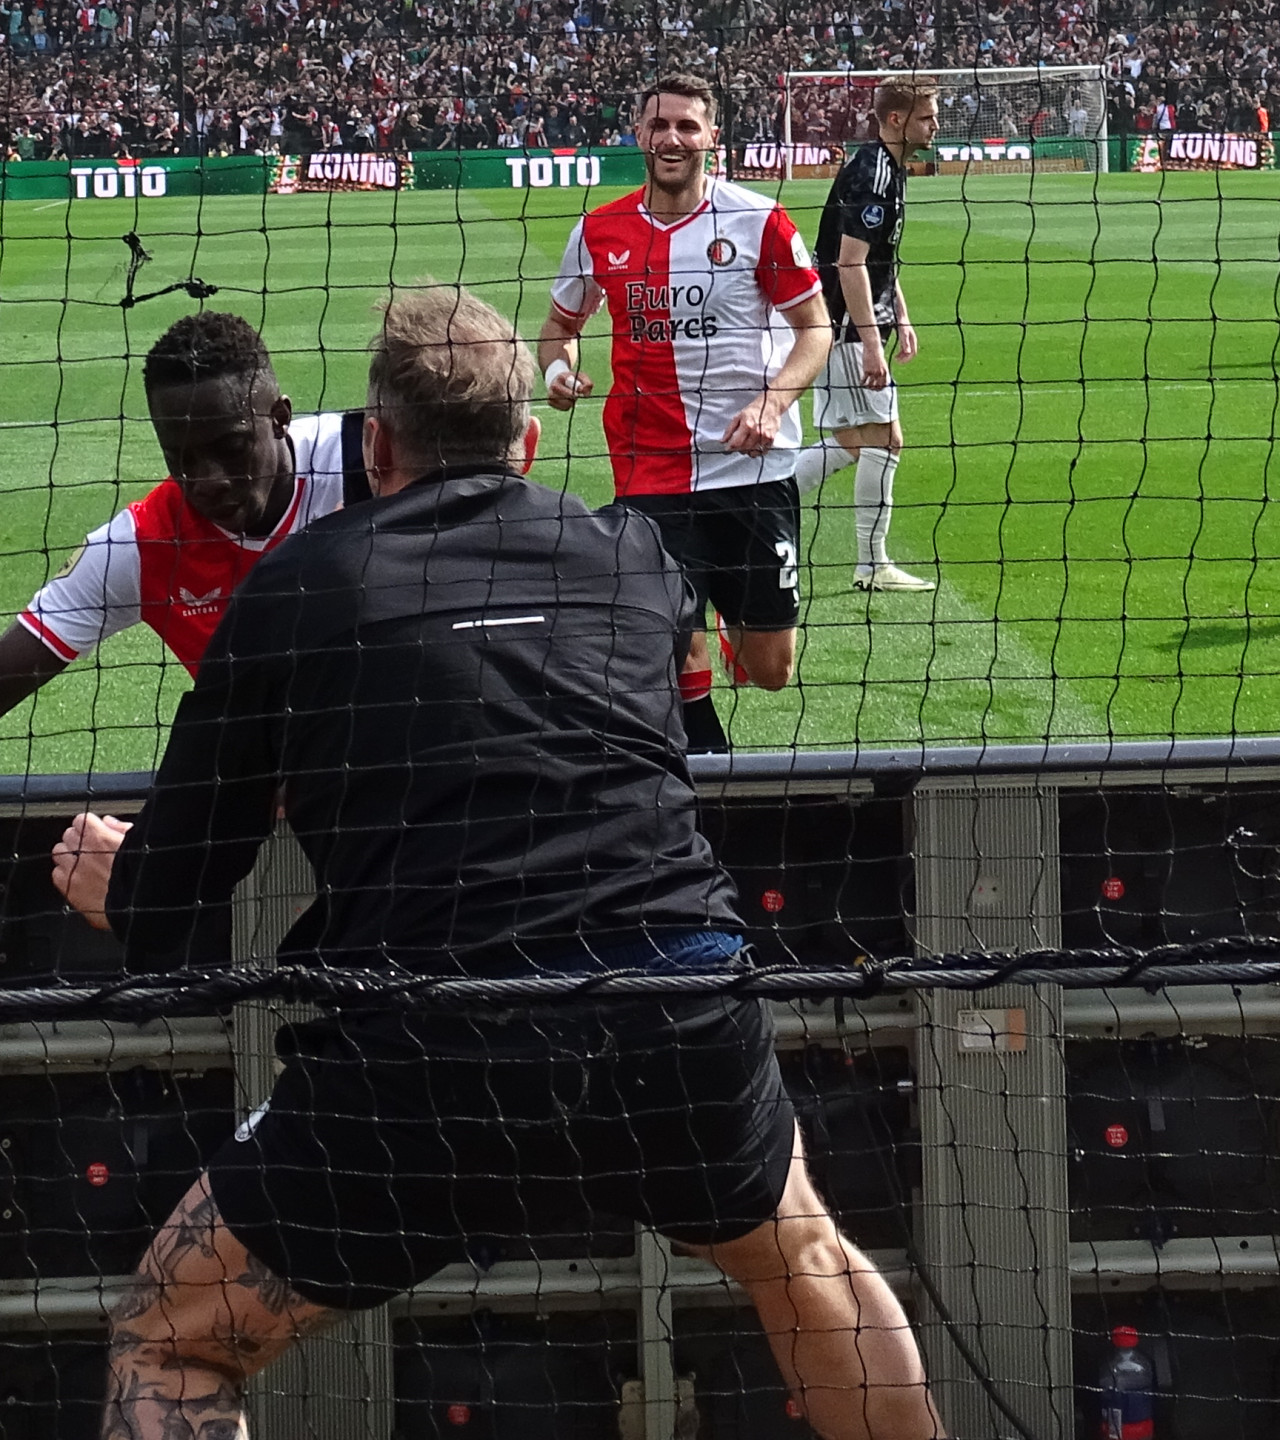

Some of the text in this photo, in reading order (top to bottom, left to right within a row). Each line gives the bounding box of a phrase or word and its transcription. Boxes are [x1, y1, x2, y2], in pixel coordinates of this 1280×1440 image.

[1170, 133, 1258, 167] KONING
[71, 166, 167, 198] TOTO
[308, 153, 397, 188] KONING
[505, 157, 601, 187] TOTO
[625, 281, 704, 313] Euro
[628, 312, 718, 344] Parcs
[182, 605, 219, 617] CASTORE
